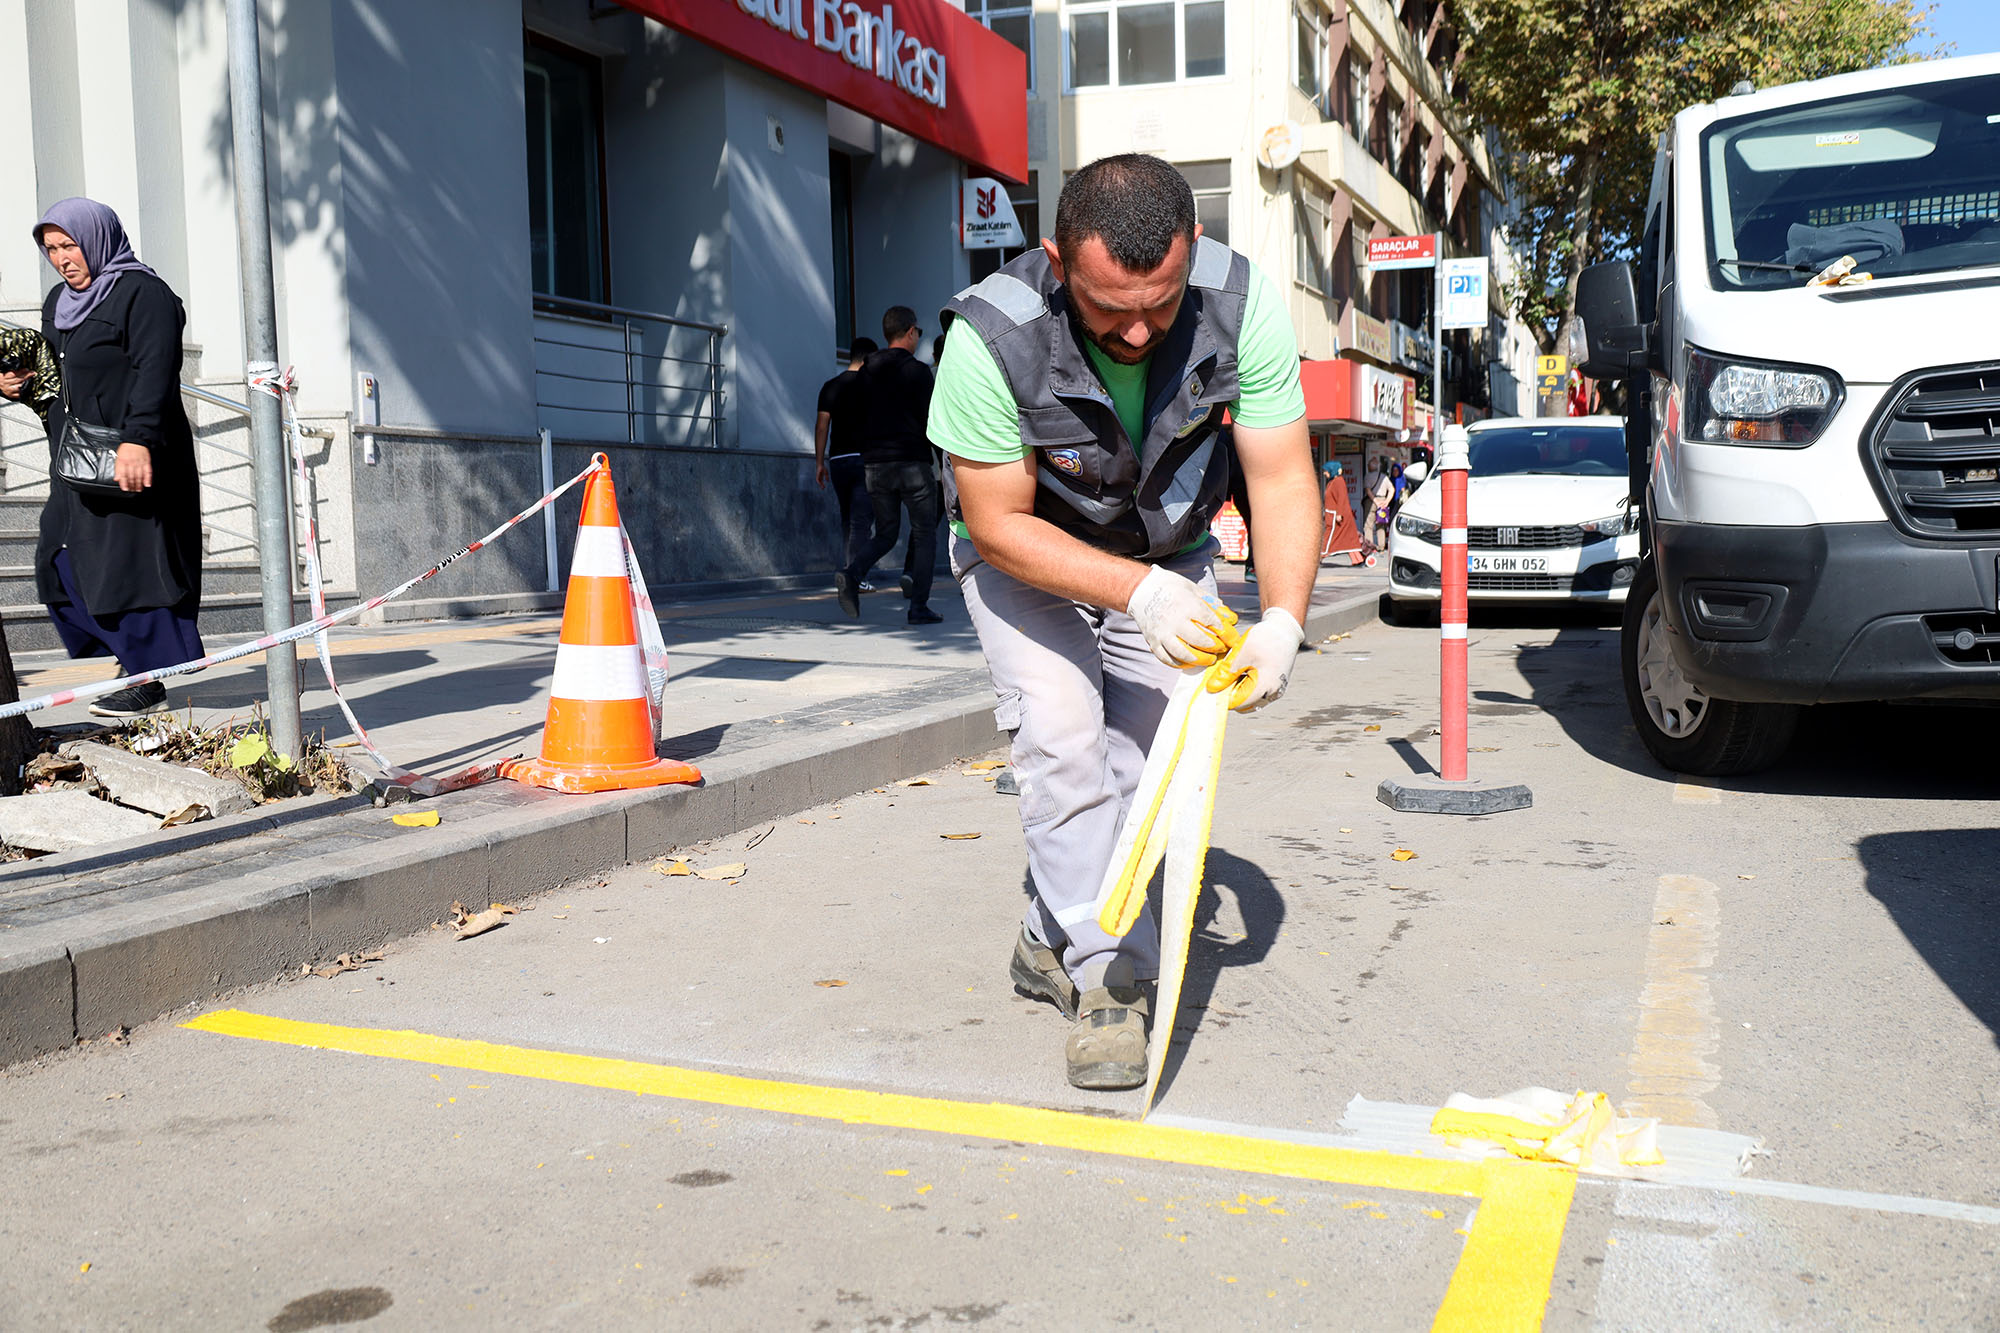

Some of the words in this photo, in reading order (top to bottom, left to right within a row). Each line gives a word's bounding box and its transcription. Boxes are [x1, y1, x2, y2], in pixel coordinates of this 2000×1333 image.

[814, 0, 946, 108] Bankası
[966, 223, 988, 232] Ziraat
[1371, 240, 1419, 254] SARAÇLAR
[1546, 358, 1557, 370] D
[1497, 527, 1520, 545] FIAT
[1473, 557, 1488, 571] 34
[1493, 558, 1517, 571] GHN
[1522, 558, 1546, 571] 052
